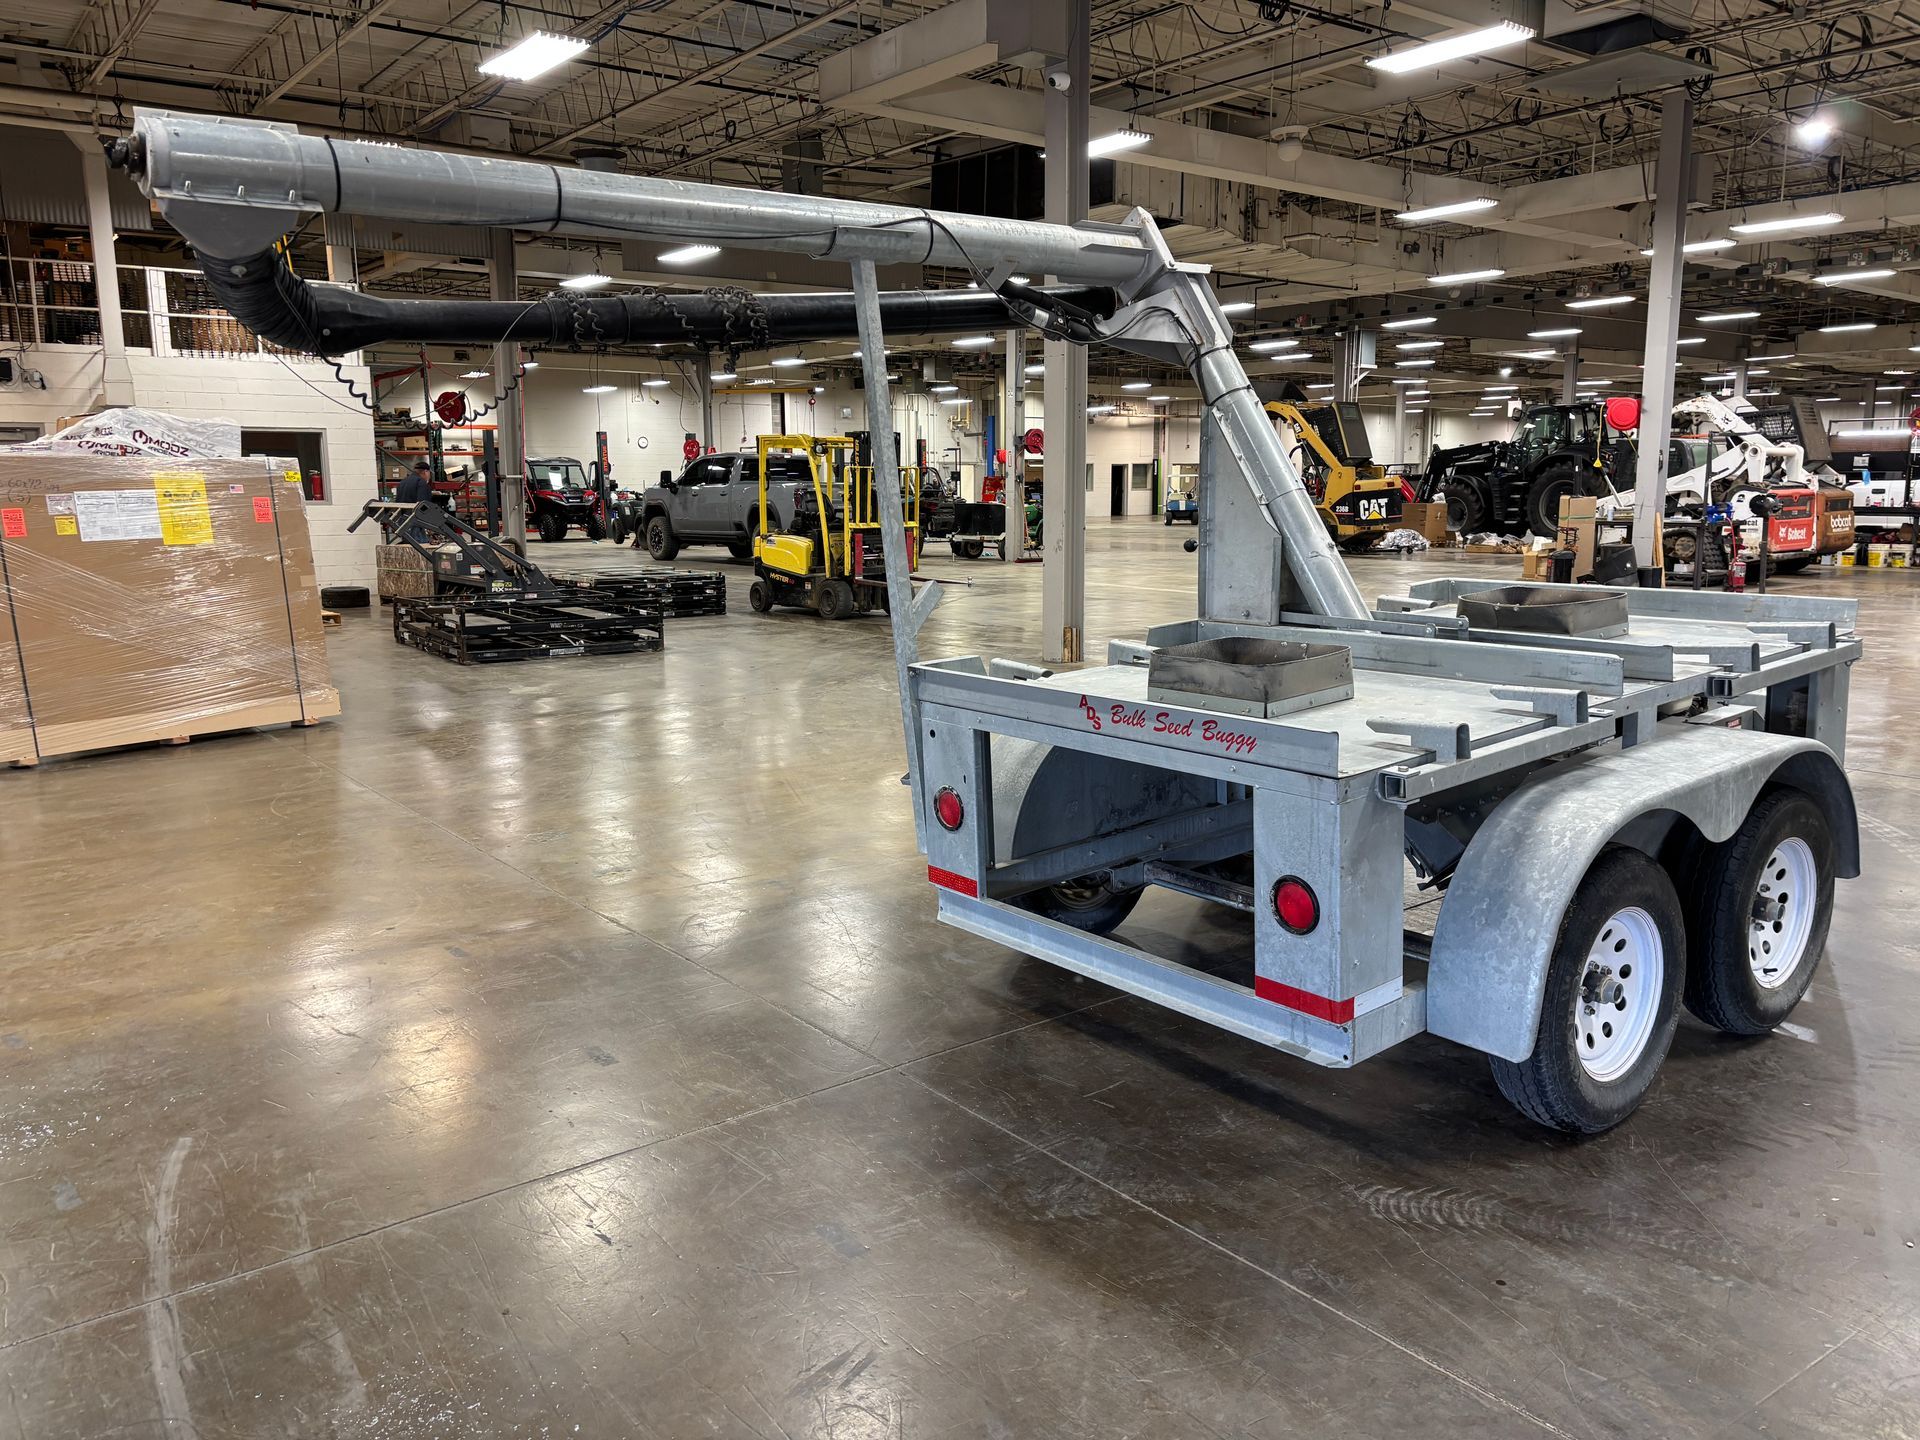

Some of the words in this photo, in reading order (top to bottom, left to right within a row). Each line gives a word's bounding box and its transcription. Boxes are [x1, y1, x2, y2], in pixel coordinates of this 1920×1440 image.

[1359, 498, 1389, 520] CAT
[1787, 527, 1807, 540] Bobcat
[769, 572, 789, 583] HYSTER
[1079, 694, 1102, 730] ADS
[1110, 704, 1147, 728] Bulk
[1153, 712, 1194, 737] Seed
[1201, 719, 1258, 754] Buggy
